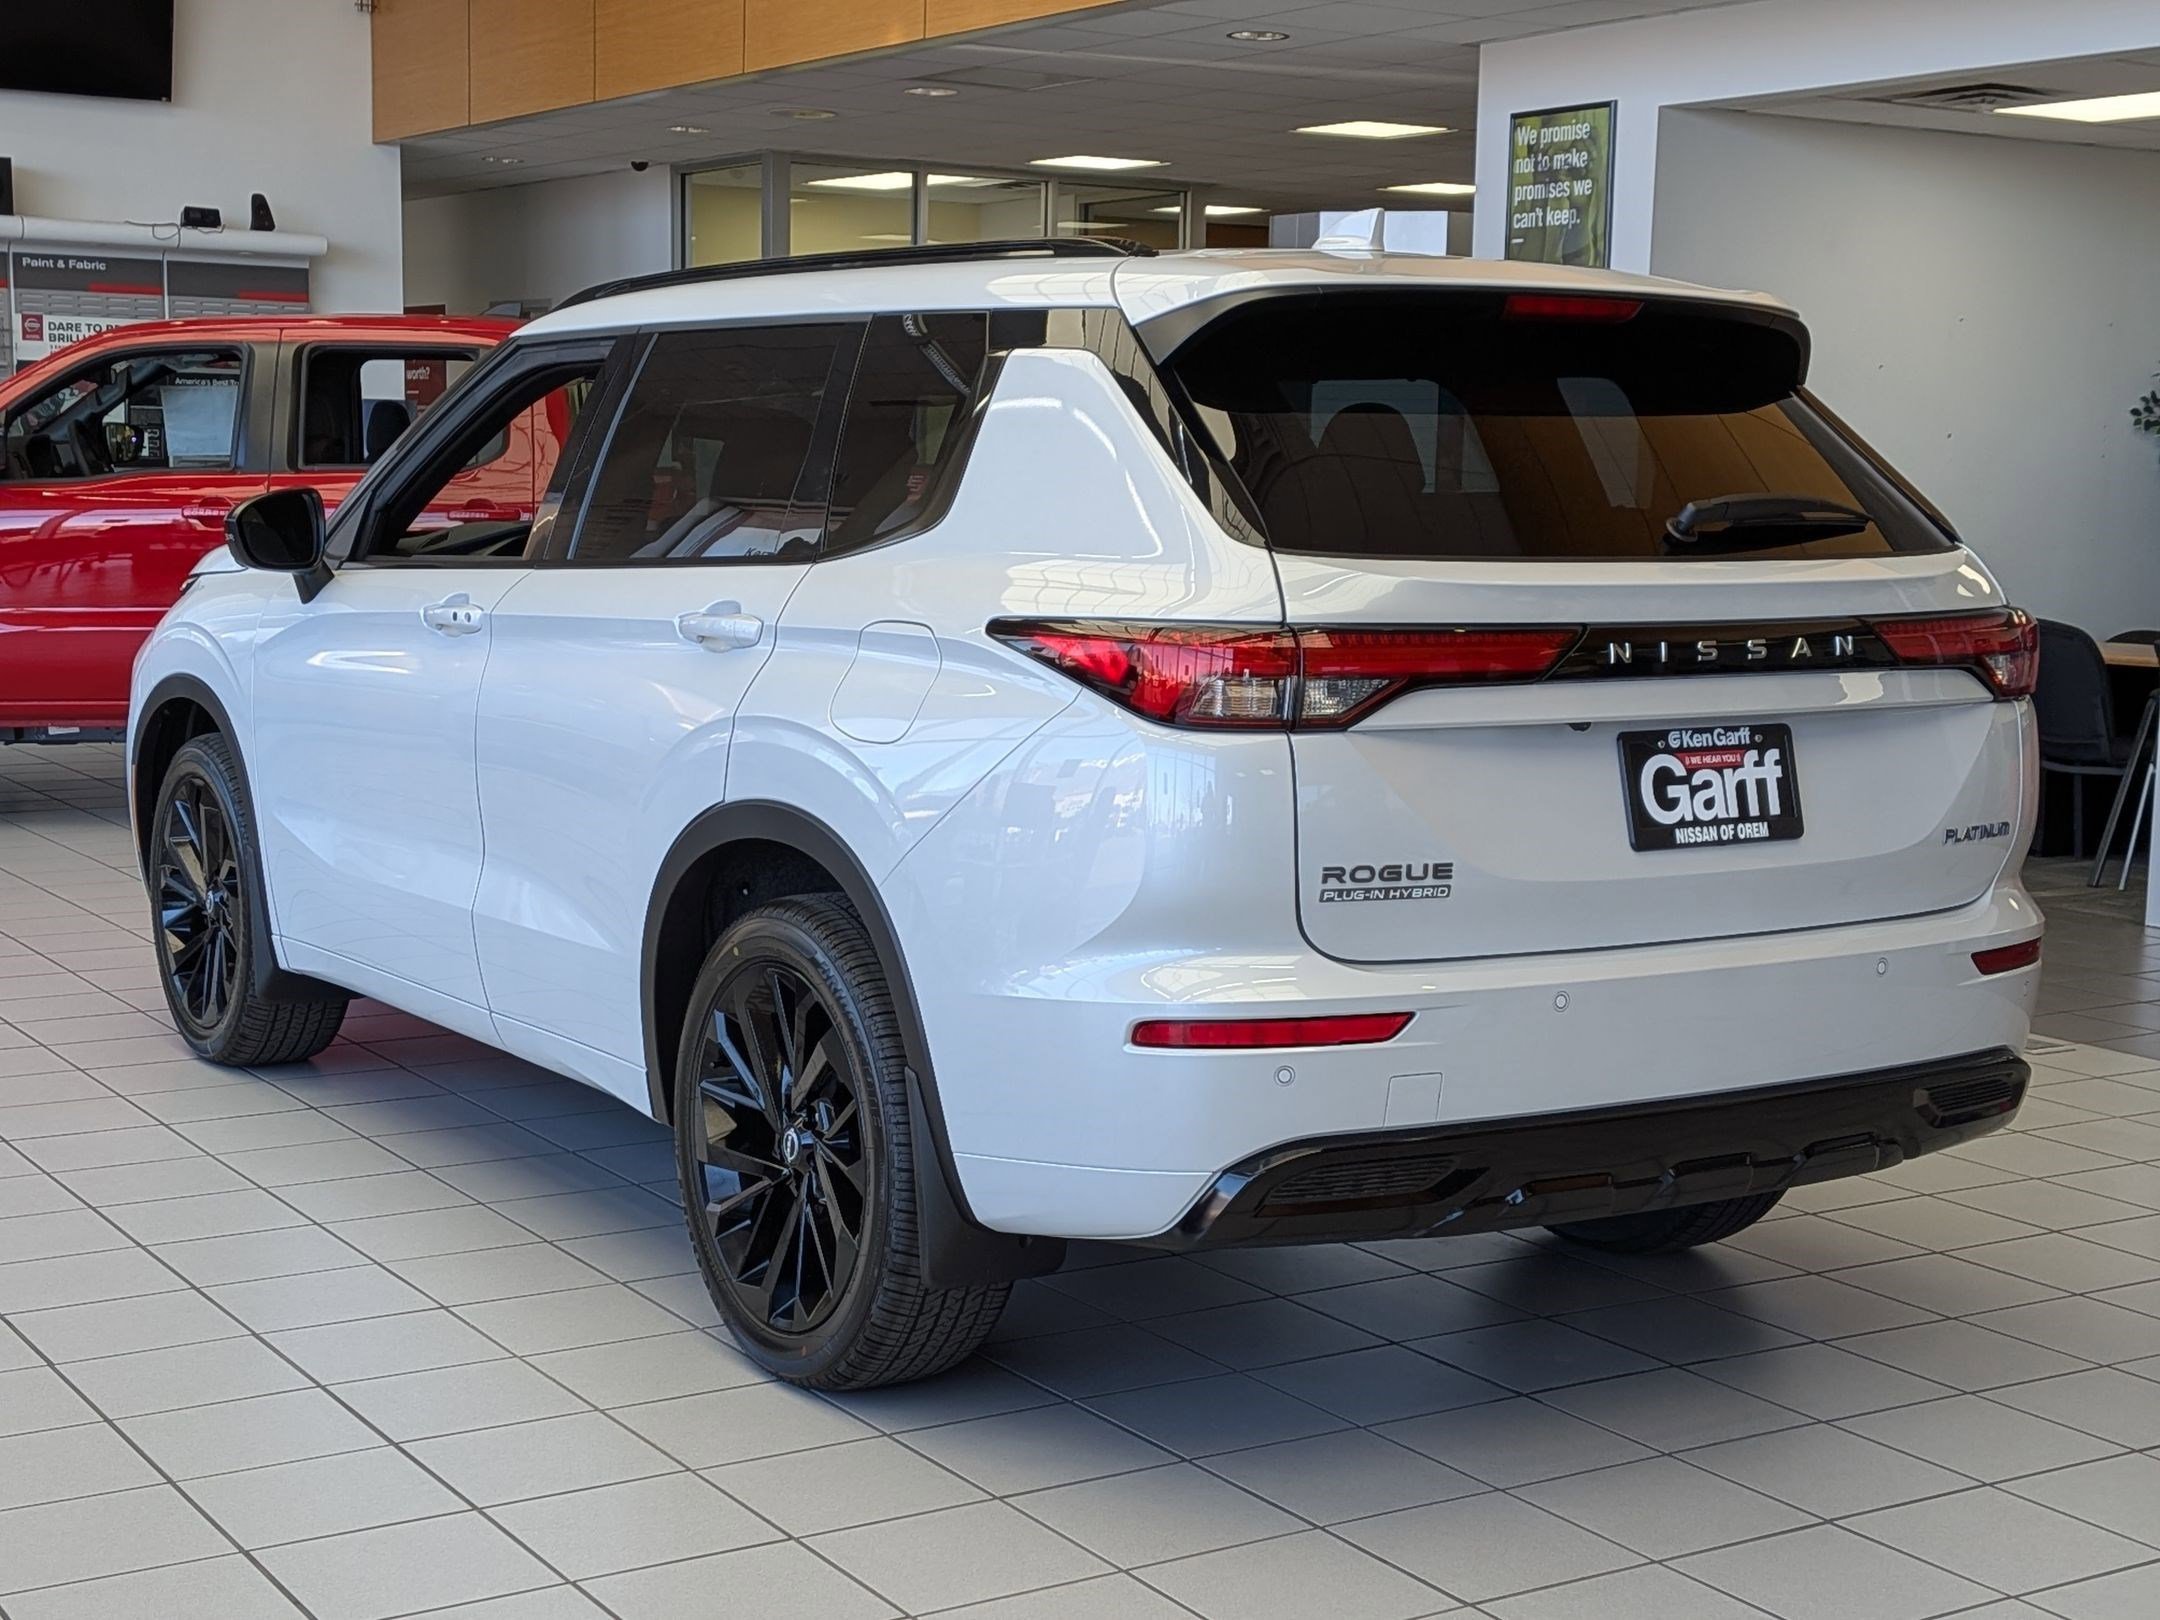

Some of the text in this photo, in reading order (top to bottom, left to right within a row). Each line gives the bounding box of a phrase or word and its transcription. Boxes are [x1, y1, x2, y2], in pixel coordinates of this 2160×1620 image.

[1516, 119, 1591, 148] We promise
[1515, 149, 1588, 174] not to make
[1514, 178, 1593, 206] promises we
[1513, 205, 1581, 230] can't keep.
[22, 256, 107, 271] Paint & Fabric
[48, 321, 82, 333] DARE
[86, 323, 103, 334] TO
[1609, 635, 1854, 664] NISSAN
[1702, 754, 1722, 765] HEAR
[1721, 753, 1736, 763] YOU
[1641, 748, 1783, 825] Garff
[1675, 821, 1769, 844] NISSAN OF OREM
[1944, 821, 2010, 844] PLATINUM
[1321, 862, 1454, 885] ROGUE
[1322, 886, 1449, 902] PLUG-IN HYBRID
